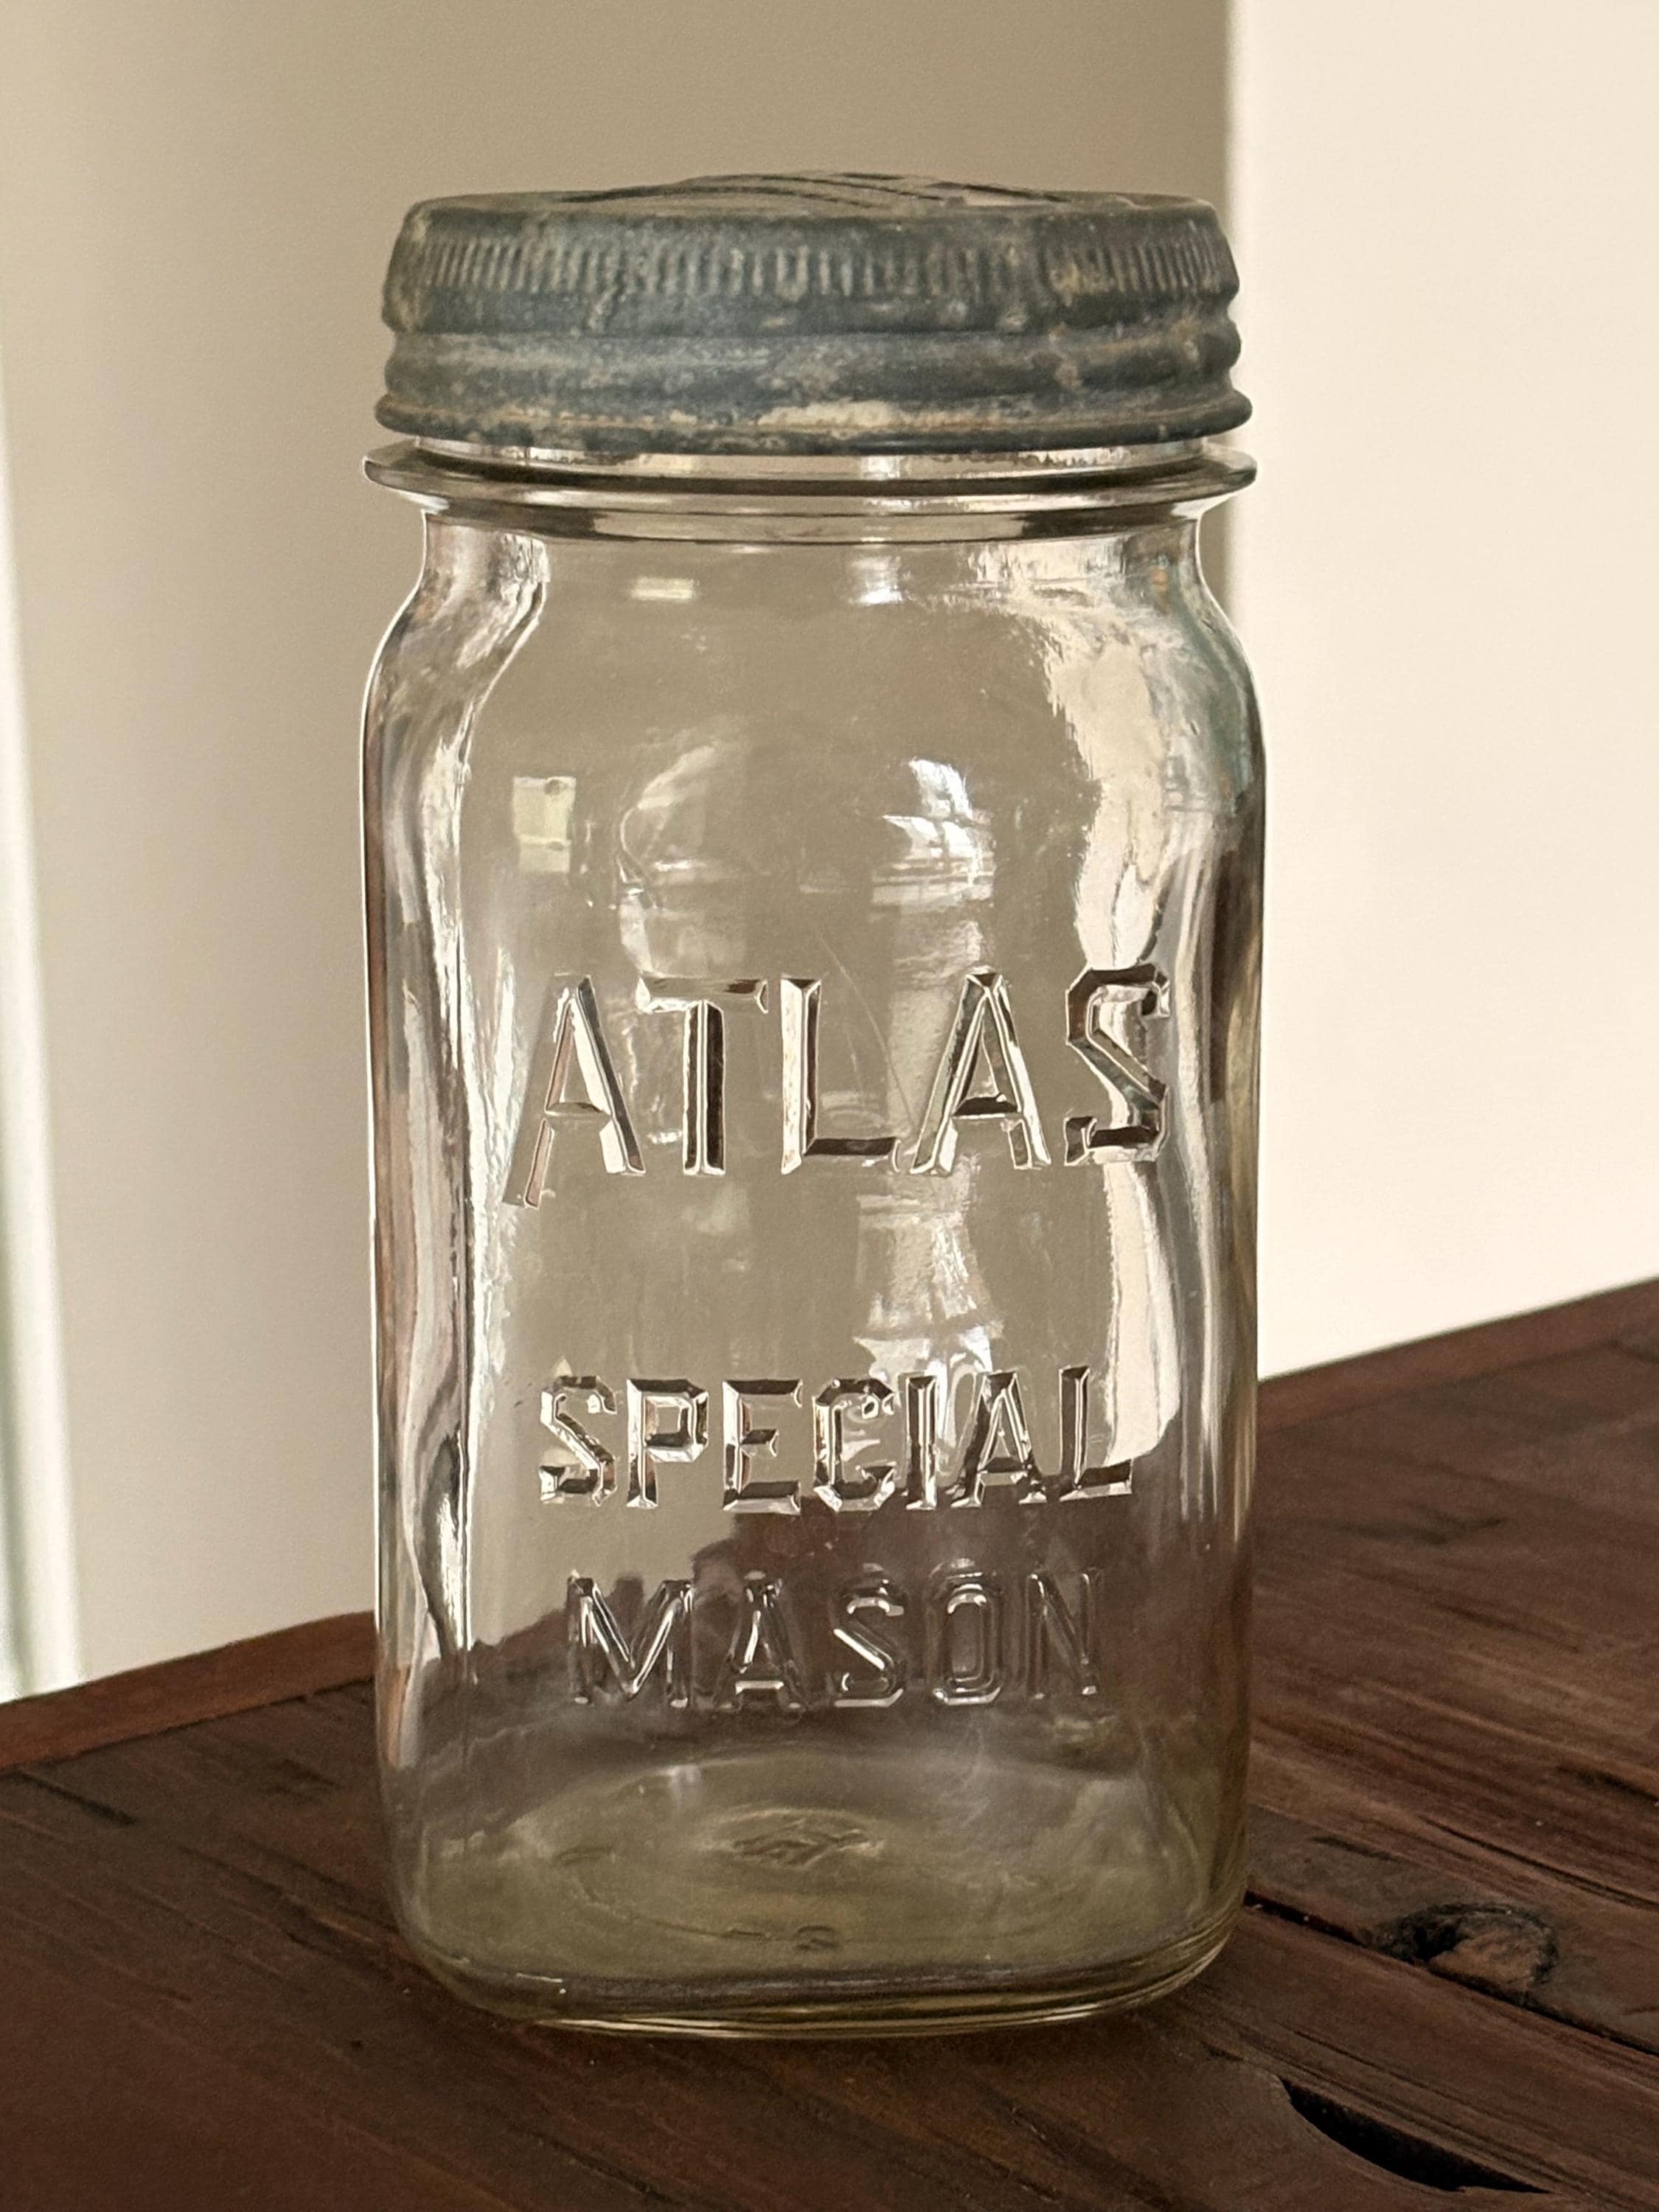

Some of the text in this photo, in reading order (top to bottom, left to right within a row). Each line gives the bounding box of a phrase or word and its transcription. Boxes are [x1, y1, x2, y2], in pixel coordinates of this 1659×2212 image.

[501, 964, 1171, 1208] ATLAS
[539, 1366, 1134, 1514] SPECIAL
[566, 1565, 1099, 1711] MASON
